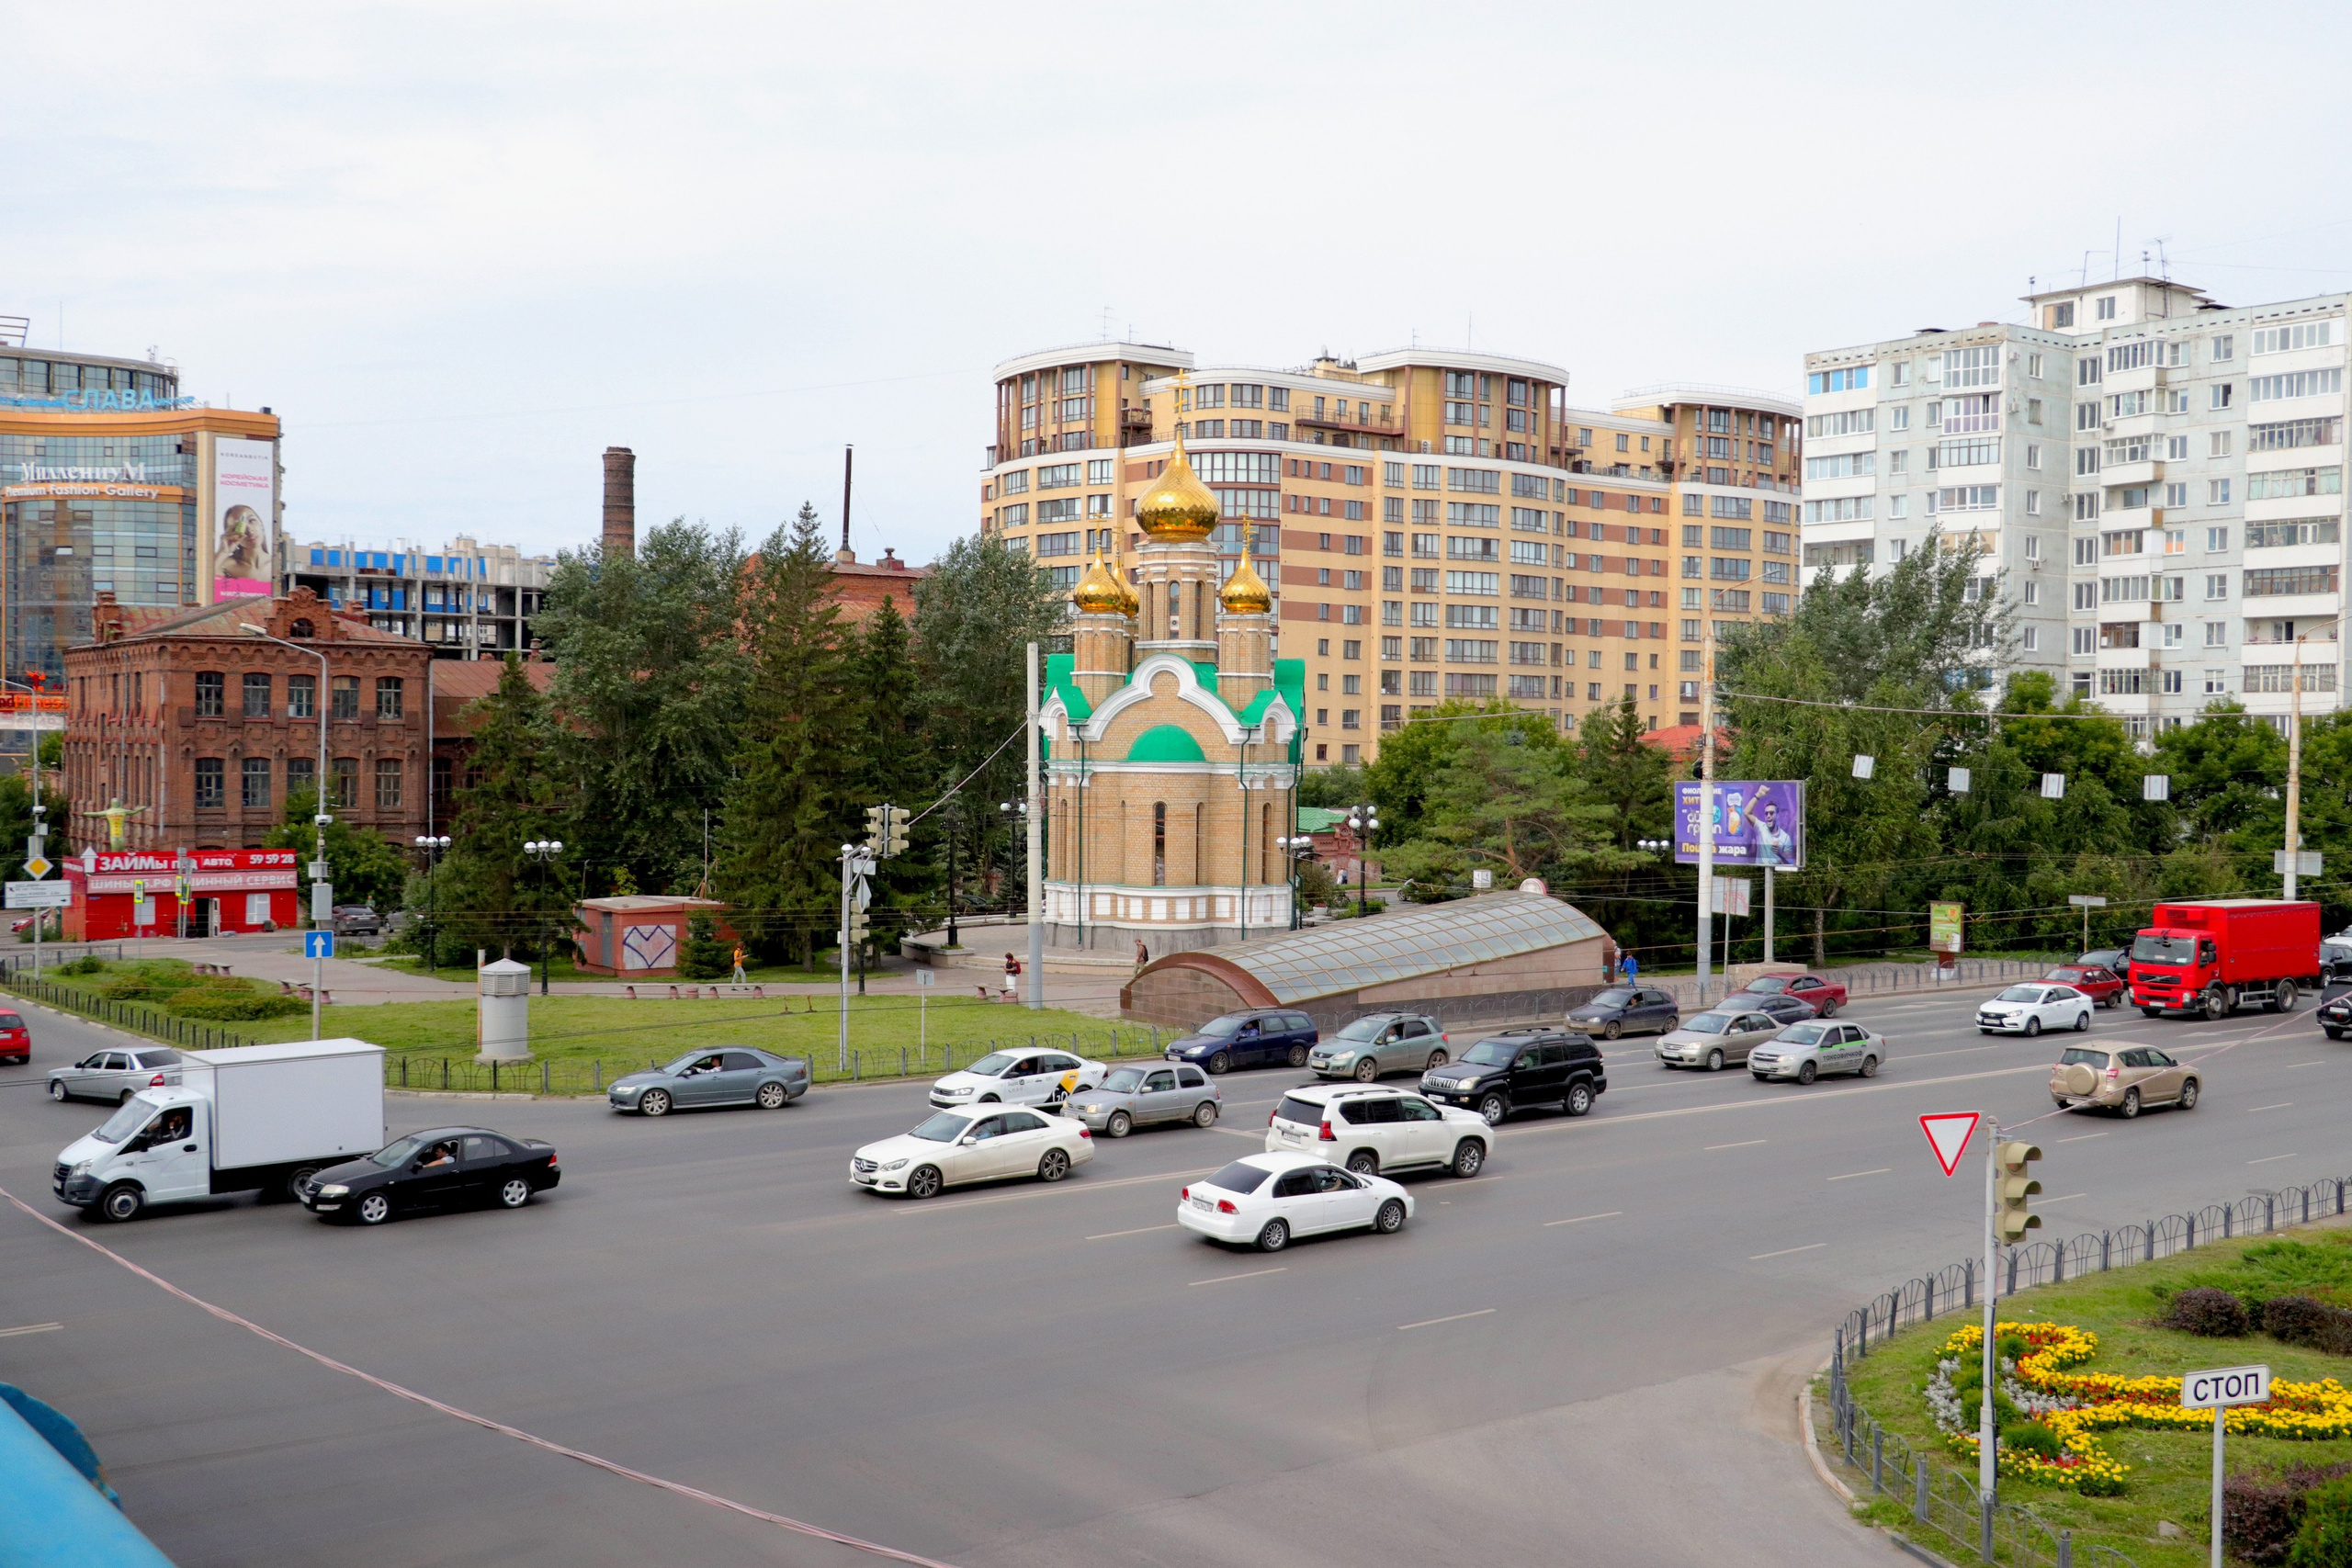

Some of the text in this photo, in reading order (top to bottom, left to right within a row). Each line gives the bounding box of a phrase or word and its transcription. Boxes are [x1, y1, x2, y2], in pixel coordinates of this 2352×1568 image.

[63, 389, 155, 410] СЛАВА
[5, 484, 160, 500] Premium Fashion Gallery
[1682, 795, 1701, 805] ХИТ
[1718, 844, 1747, 856] жара
[249, 854, 264, 864] 59
[265, 854, 279, 864] 59
[280, 853, 295, 864] 28
[246, 874, 295, 886] СЕРВИС
[2193, 1372, 2259, 1402] СТОП
